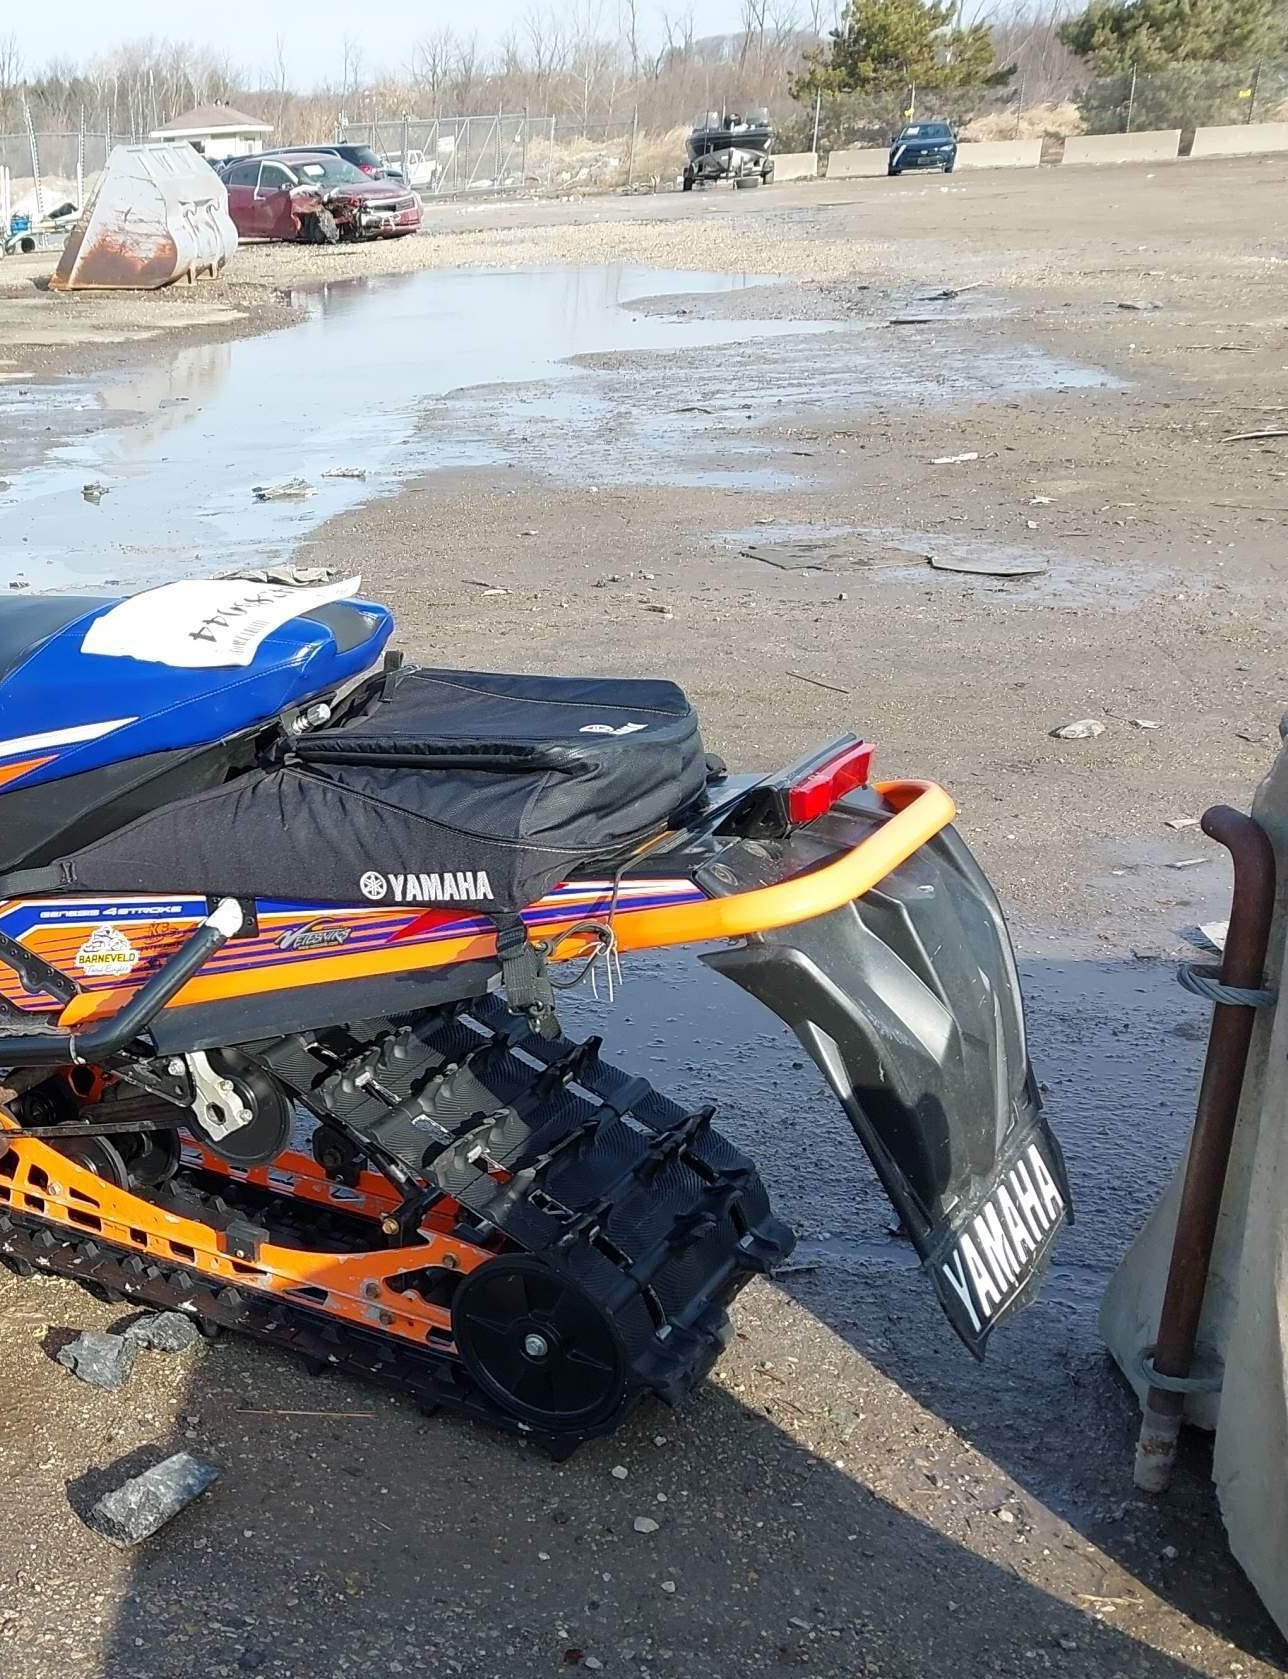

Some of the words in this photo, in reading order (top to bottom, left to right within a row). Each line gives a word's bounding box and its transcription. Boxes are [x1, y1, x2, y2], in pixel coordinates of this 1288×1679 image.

[387, 871, 494, 901] YAMAHA
[78, 952, 136, 964] BARNEVELD
[941, 1143, 1065, 1333] YAMAHA
